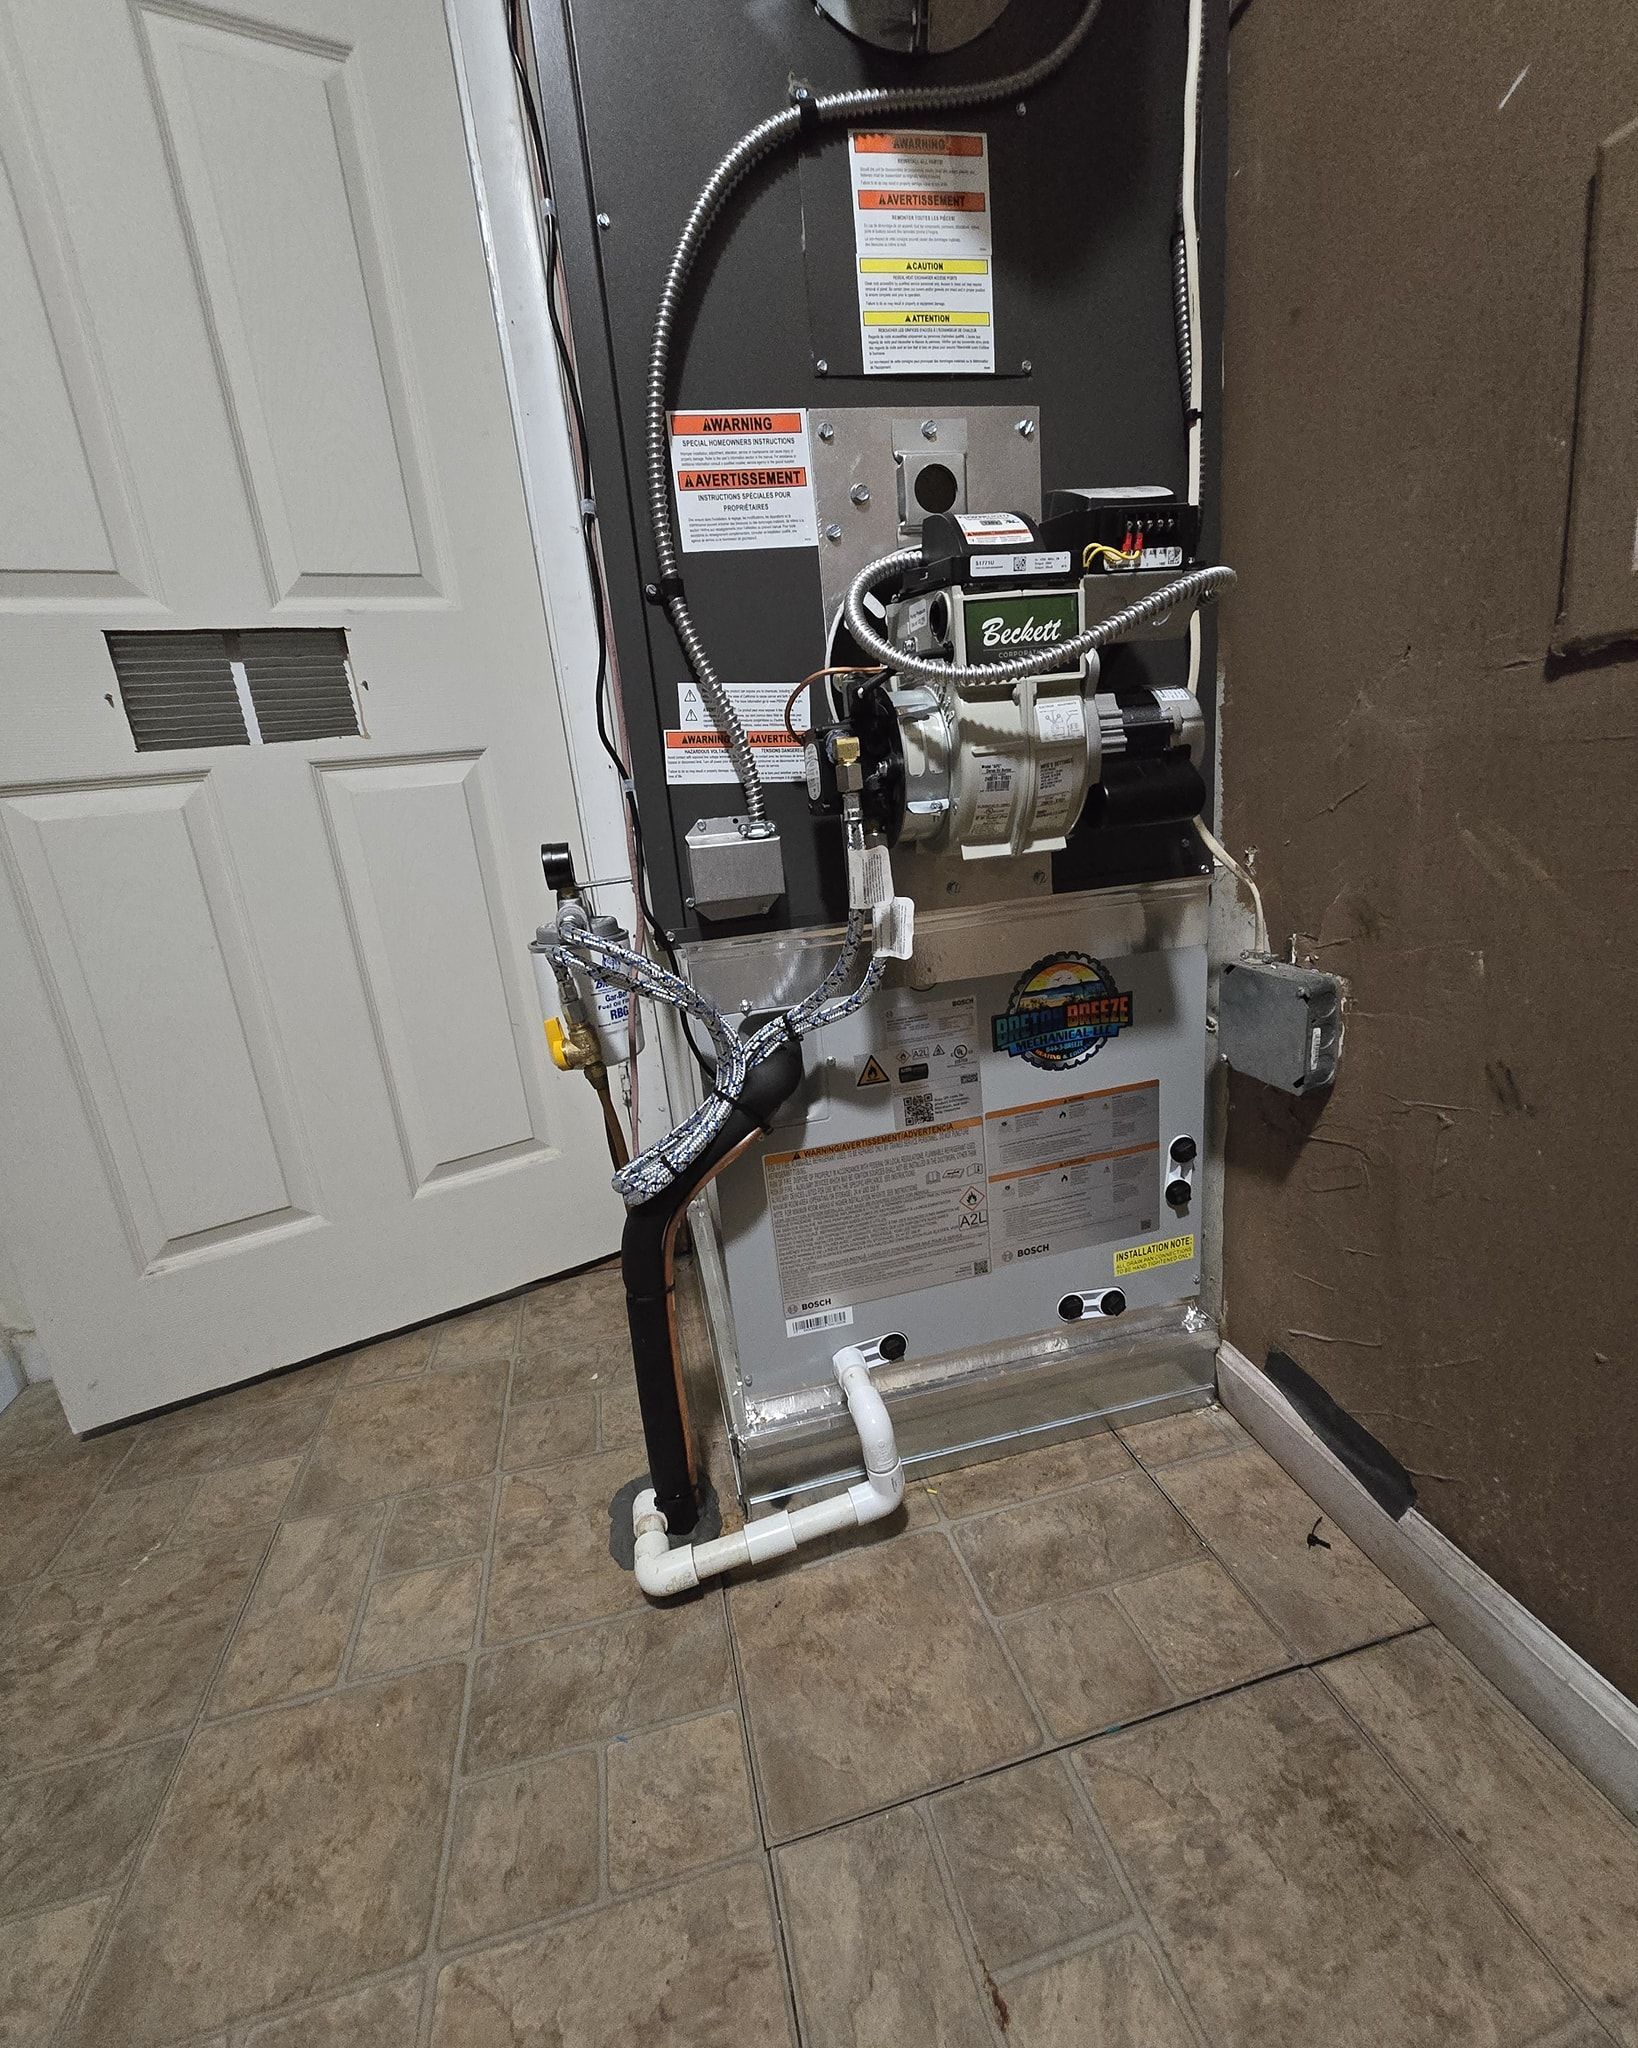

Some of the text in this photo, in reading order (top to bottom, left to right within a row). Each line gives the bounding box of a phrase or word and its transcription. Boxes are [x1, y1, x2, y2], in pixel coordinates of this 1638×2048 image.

[899, 138, 945, 150] WARNING
[887, 194, 965, 207] AVERTISSEMENT
[912, 262, 944, 271] CAUTION
[911, 315, 950, 323] ATTENTION
[711, 417, 773, 432] WARNING
[709, 438, 752, 446] HOMEOWNERS
[753, 437, 796, 446] INSTRUCTIONS
[696, 471, 801, 488] AVERTISSEMENT
[698, 493, 741, 502] INSTRUCTIONS
[774, 491, 792, 499] POUR
[981, 616, 1063, 647] Beckett
[998, 648, 1046, 659] CORPORAT
[687, 735, 731, 744] WARNING
[756, 734, 799, 743] AVERTIS
[952, 998, 974, 1007] BOSCH
[1066, 995, 1129, 1028] BREEZE
[913, 1048, 928, 1057] A2L
[960, 1212, 987, 1227] A2L
[1017, 1243, 1050, 1258] BOSCH
[1116, 1236, 1193, 1262] INSTALLATION NOTE:
[1154, 1246, 1192, 1260] CONNECTIONS
[1148, 1256, 1177, 1267] TIGHTENED
[801, 1298, 832, 1311] BOSCH
